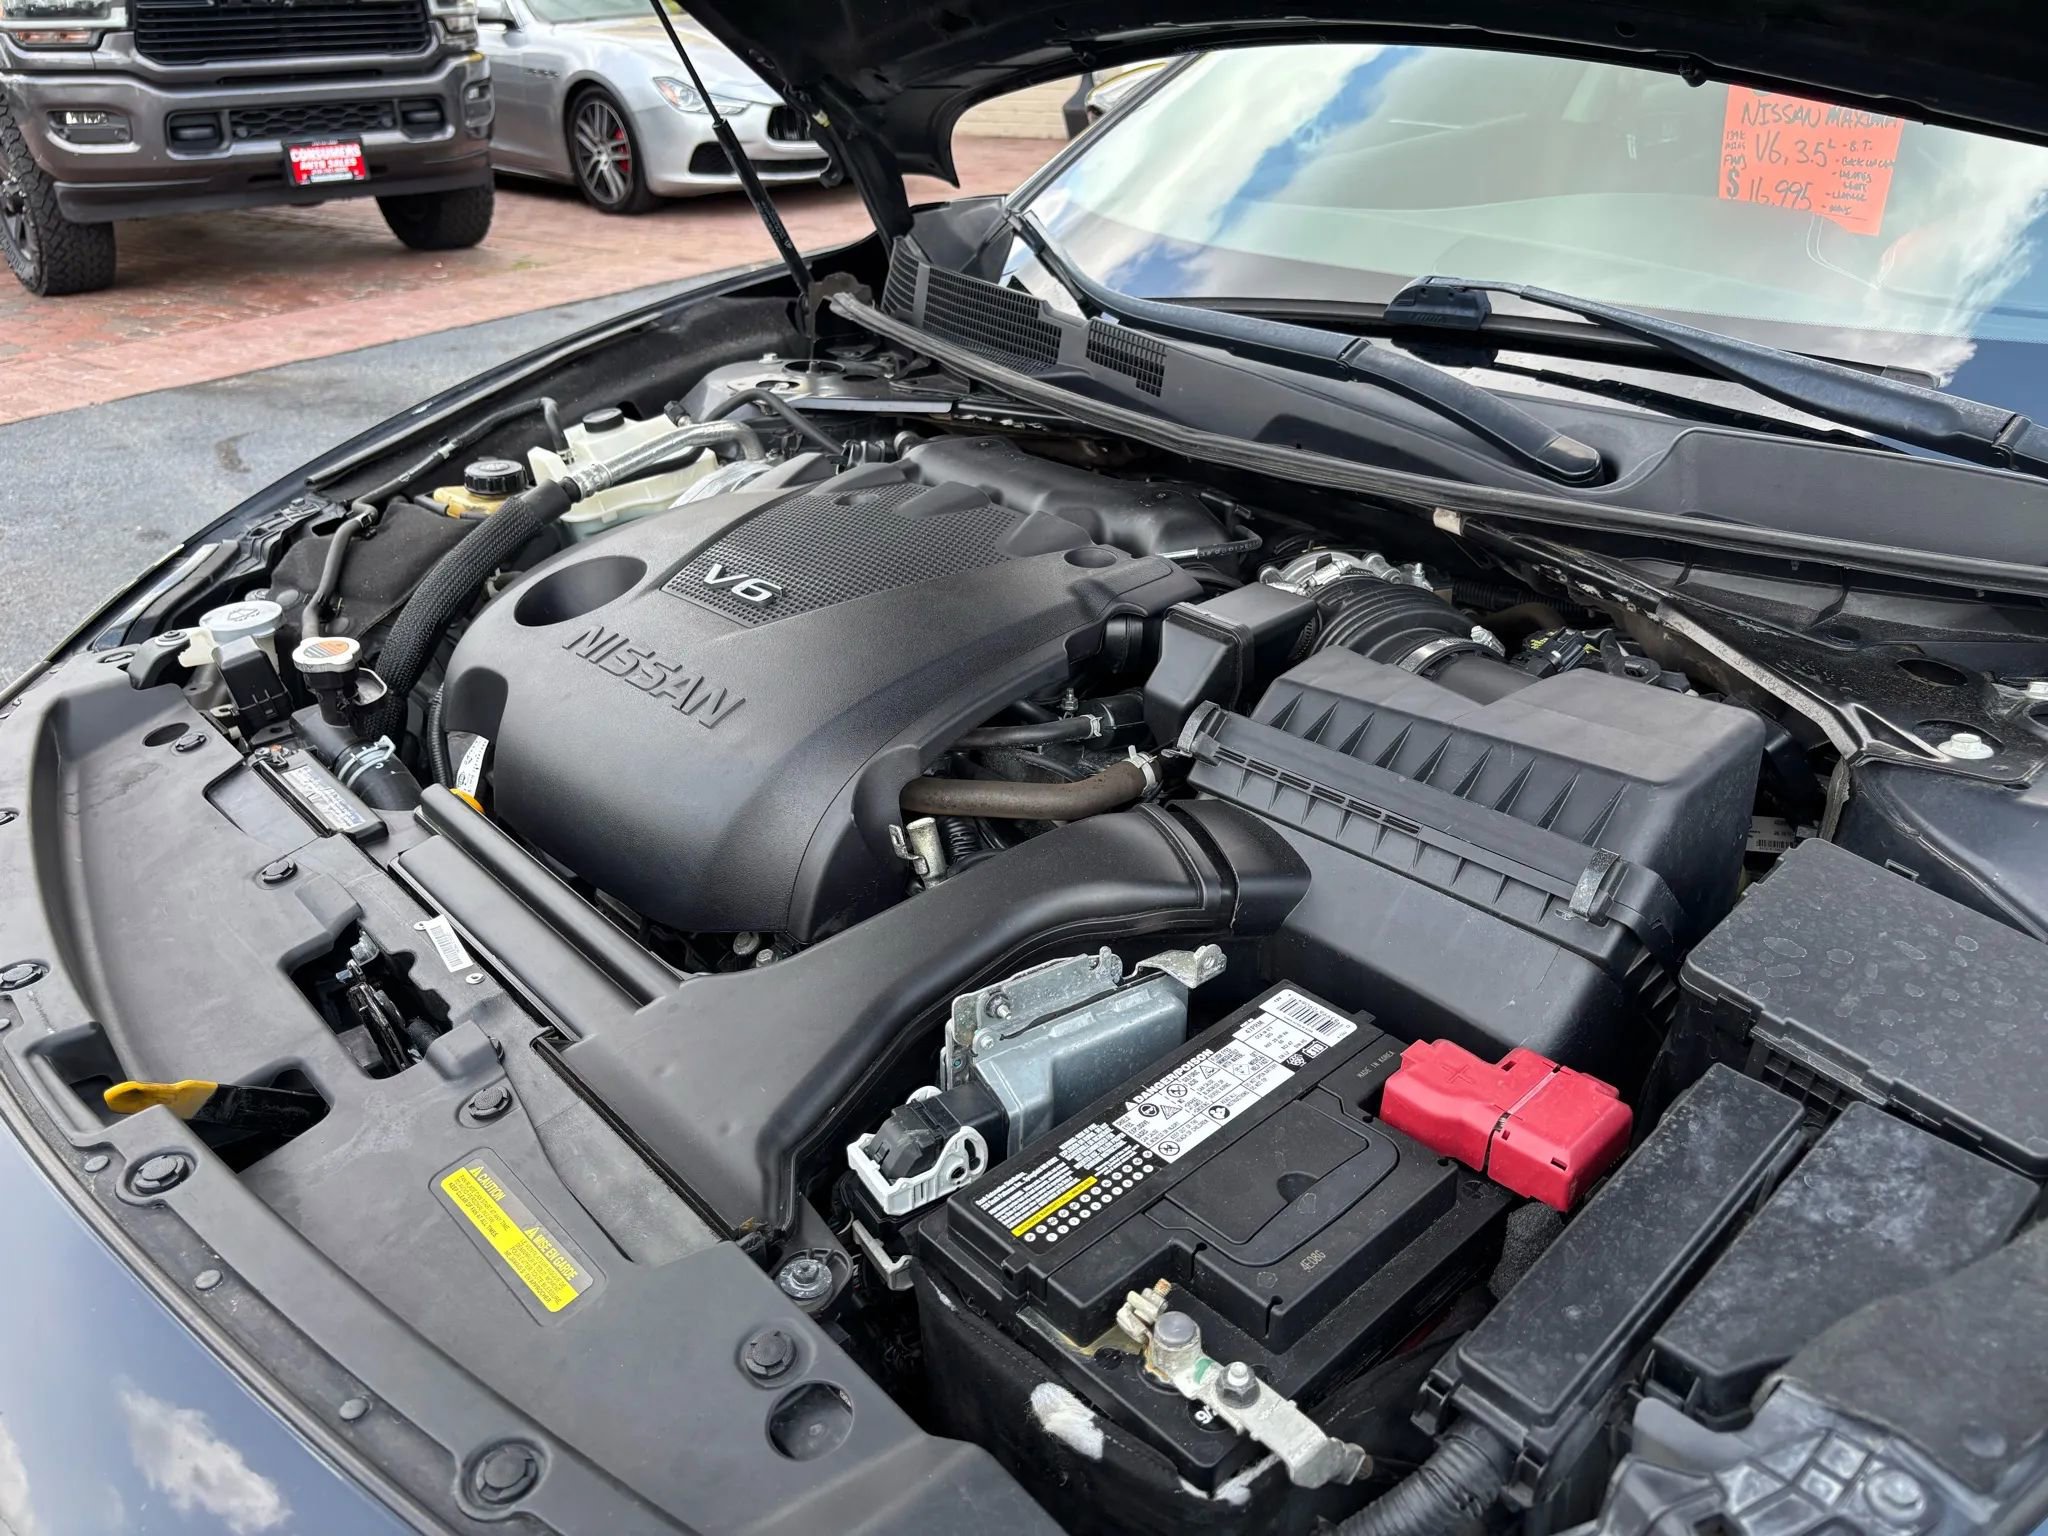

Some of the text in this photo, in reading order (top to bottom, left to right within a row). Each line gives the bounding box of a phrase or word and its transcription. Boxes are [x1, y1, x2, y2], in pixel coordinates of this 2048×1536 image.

[1740, 100, 1897, 129] NISSAN MAXIMA
[290, 143, 361, 162] CONSUMERS
[300, 156, 357, 170] AUTO SALES
[703, 563, 783, 606] V6
[562, 625, 746, 729] NISSAN
[1132, 1048, 1214, 1104] DANGER/POISON
[1356, 1066, 1373, 1079] MADE
[447, 1182, 458, 1192] KEEP
[455, 1190, 468, 1203] CLEAR
[477, 1174, 505, 1201] CAUTION
[533, 1235, 577, 1280] MISE EN GARDE
